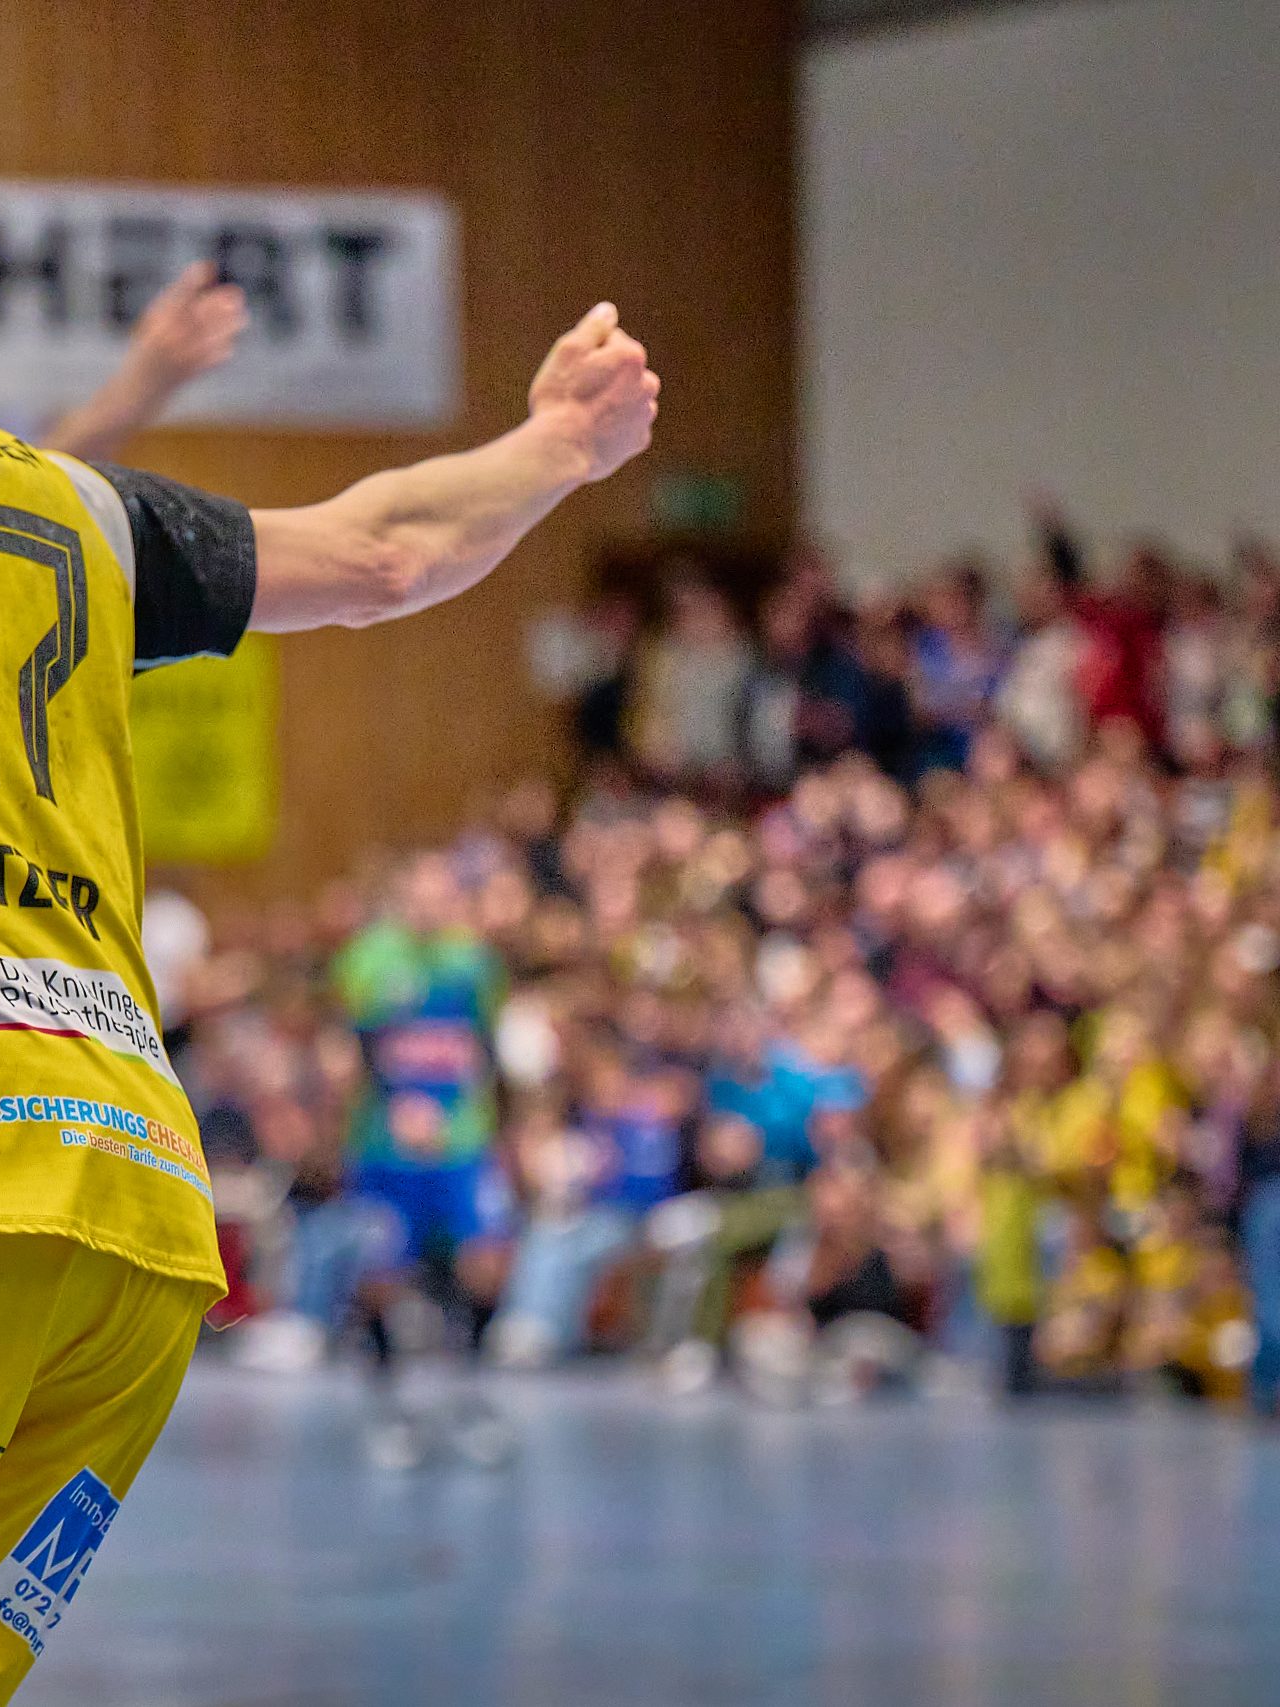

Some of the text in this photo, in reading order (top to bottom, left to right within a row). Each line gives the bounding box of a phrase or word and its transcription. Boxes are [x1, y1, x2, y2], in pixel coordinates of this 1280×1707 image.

[62, 1130, 87, 1145] Die
[89, 1132, 126, 1156] besten
[128, 1145, 157, 1168] Tarife
[159, 1159, 180, 1177] zum
